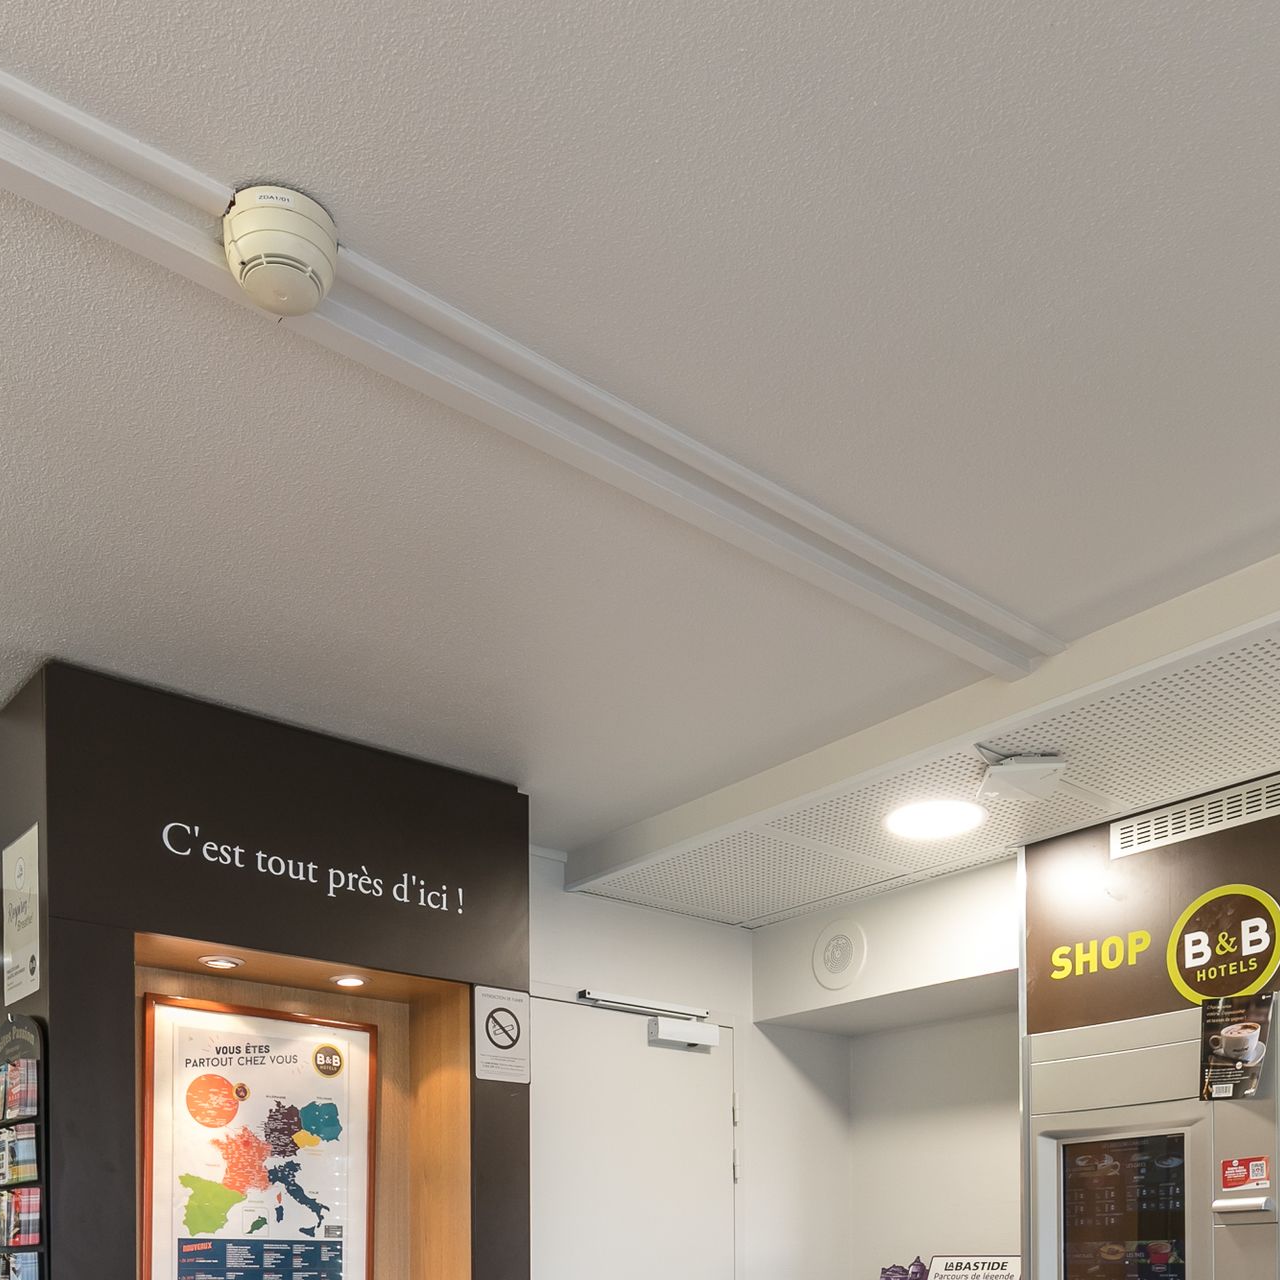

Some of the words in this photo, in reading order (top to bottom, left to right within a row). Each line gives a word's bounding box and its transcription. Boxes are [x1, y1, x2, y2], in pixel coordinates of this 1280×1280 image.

[161, 822, 246, 868] C'est
[256, 850, 319, 884] tout
[327, 865, 384, 898] près
[392, 873, 449, 912] d'ici
[1183, 917, 1271, 969] B&B
[1050, 929, 1152, 980] SHOP
[1196, 957, 1258, 983] HOTELS
[215, 1045, 241, 1055] VOUS
[245, 1042, 270, 1054] ÊTES
[185, 1056, 233, 1068] PARTOUT
[237, 1055, 266, 1065] CHEZ
[270, 1054, 298, 1064] VOUS
[316, 1053, 341, 1067] B&B
[933, 1272, 969, 1280] Parcours
[970, 1272, 981, 1280] de
